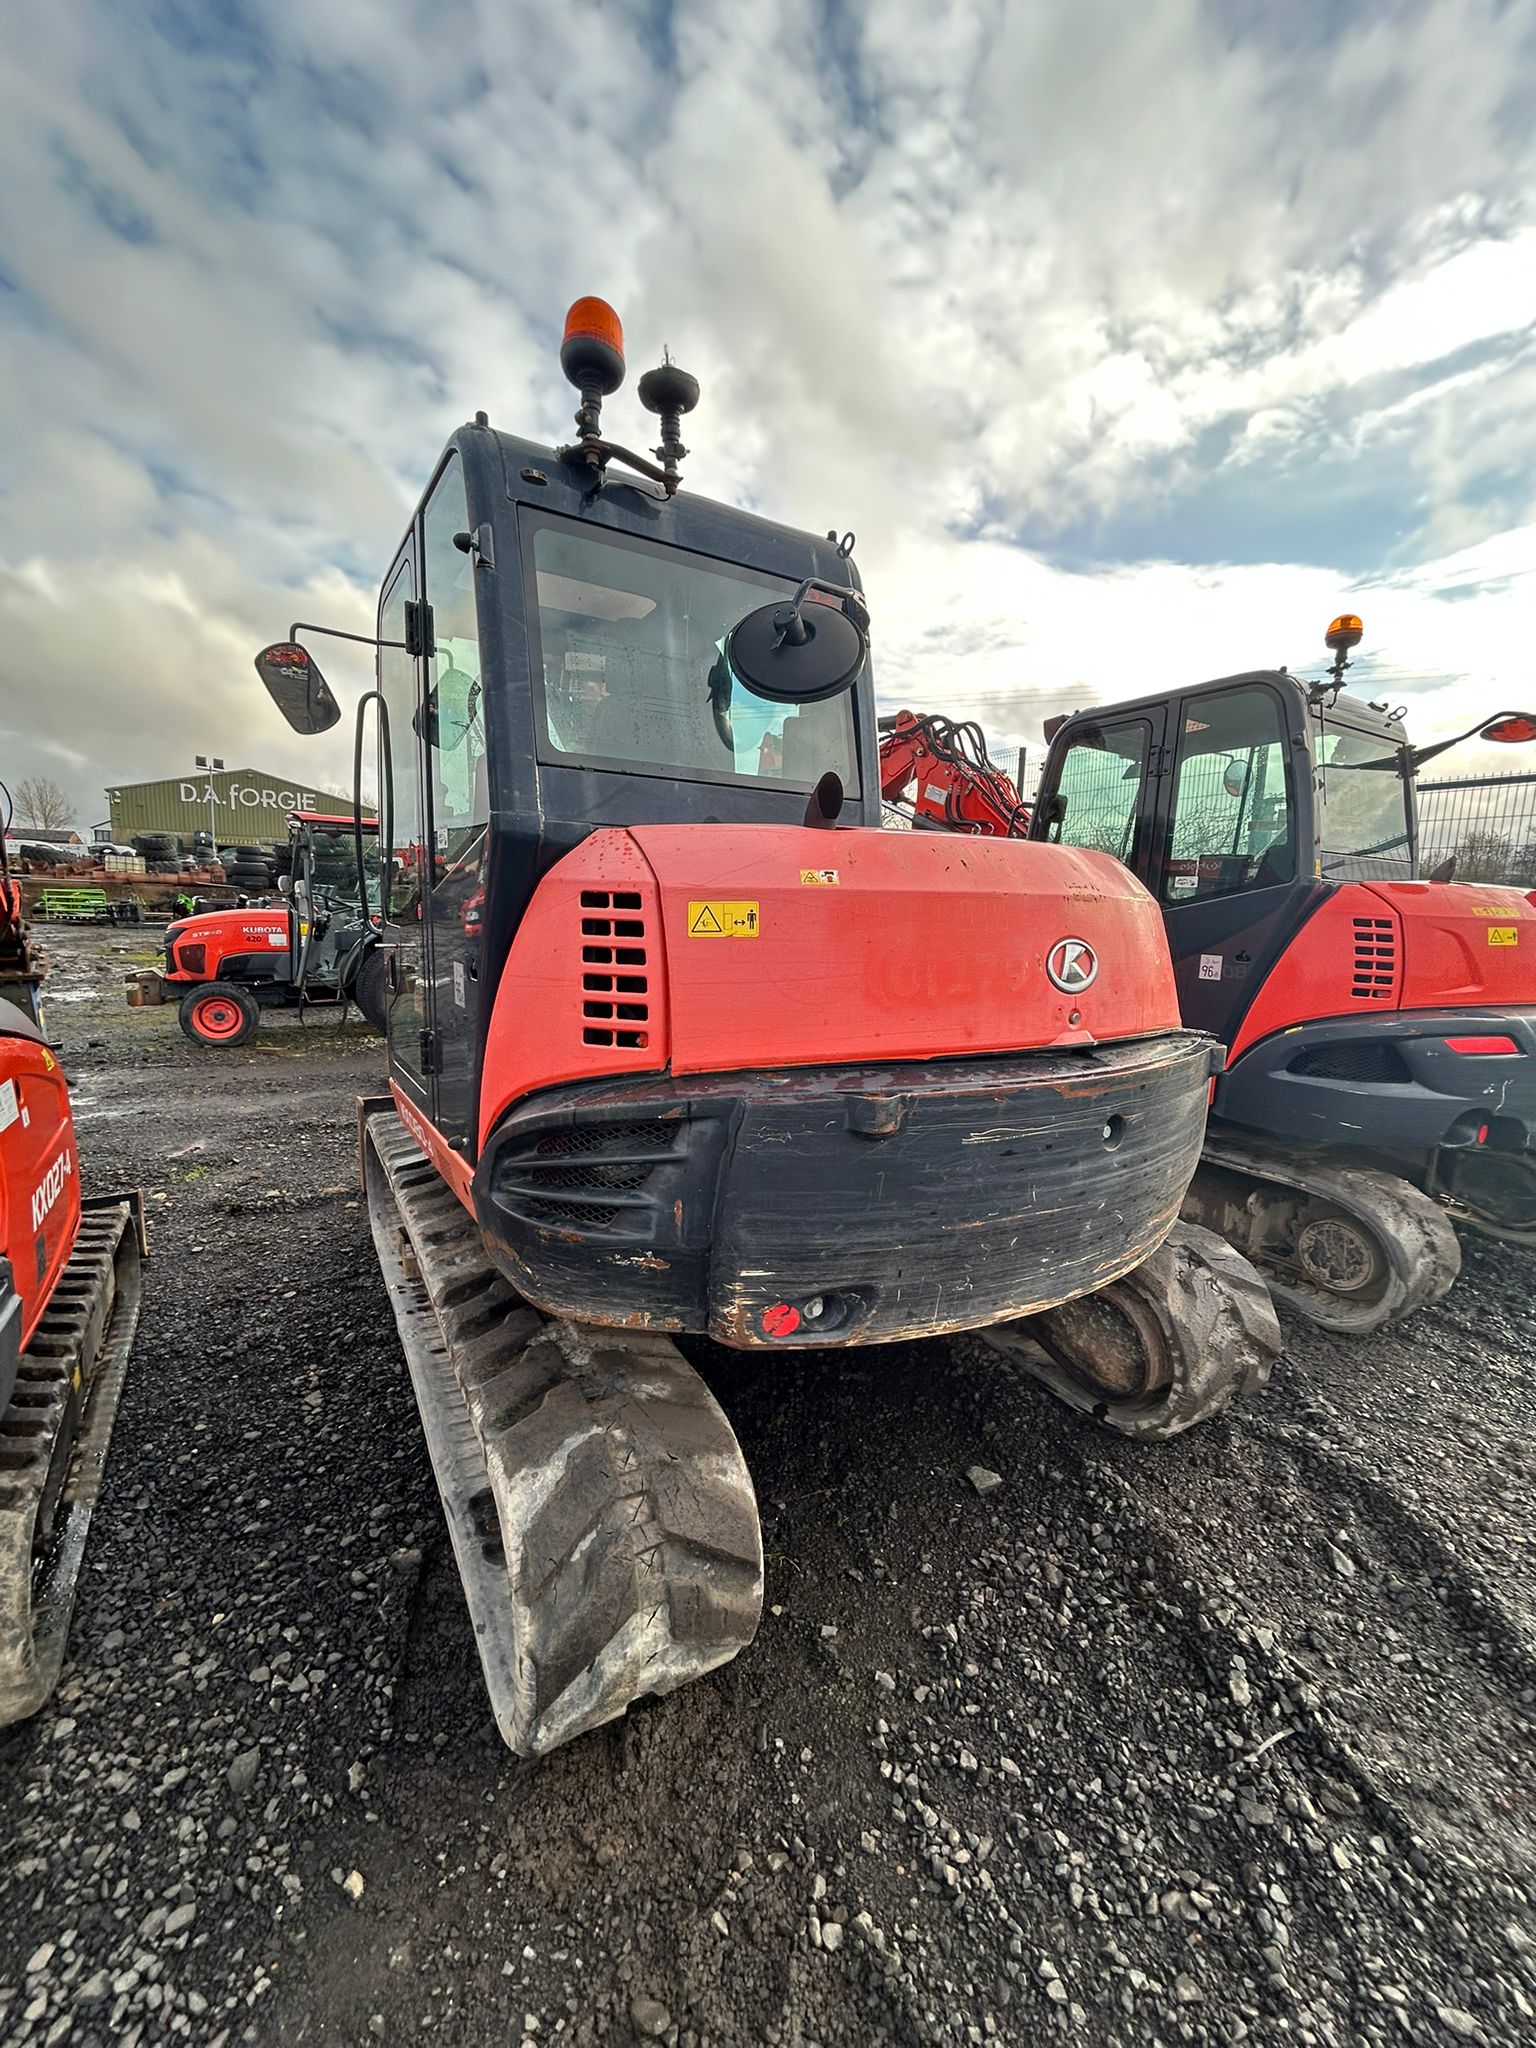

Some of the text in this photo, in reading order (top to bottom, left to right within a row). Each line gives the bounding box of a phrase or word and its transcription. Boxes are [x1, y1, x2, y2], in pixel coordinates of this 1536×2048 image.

[242, 926, 283, 934] KUBOTA
[245, 935, 262, 943] 420
[1201, 964, 1214, 978] 96
[31, 1148, 72, 1233] KX027-4
